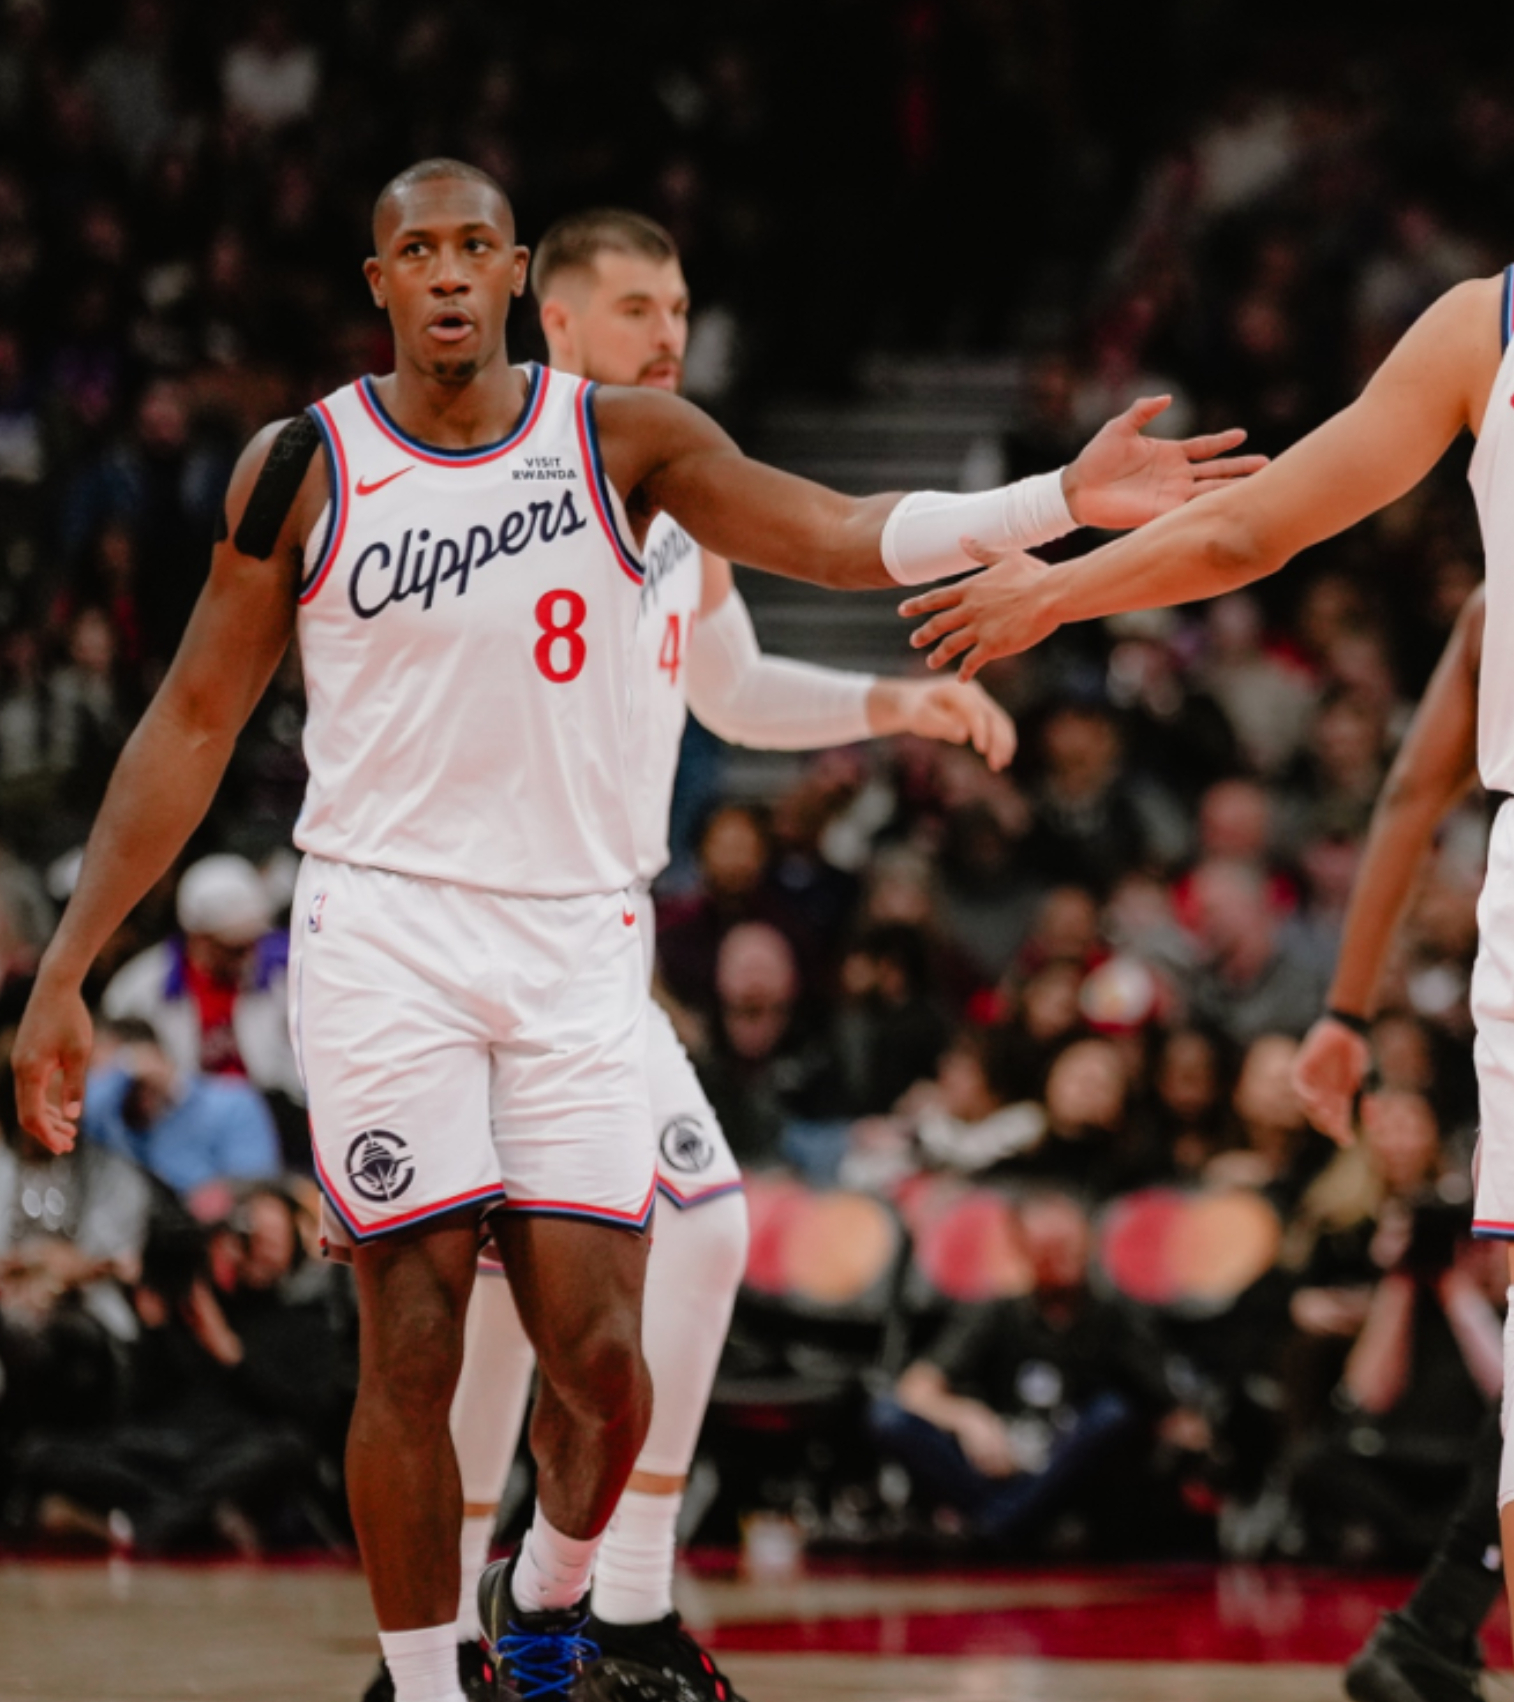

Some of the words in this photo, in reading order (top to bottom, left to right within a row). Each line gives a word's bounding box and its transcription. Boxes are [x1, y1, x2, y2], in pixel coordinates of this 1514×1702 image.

[511, 468, 578, 480] RWANDA
[523, 457, 562, 468] VISIT
[348, 489, 587, 619] Clippers
[533, 589, 587, 684] 8
